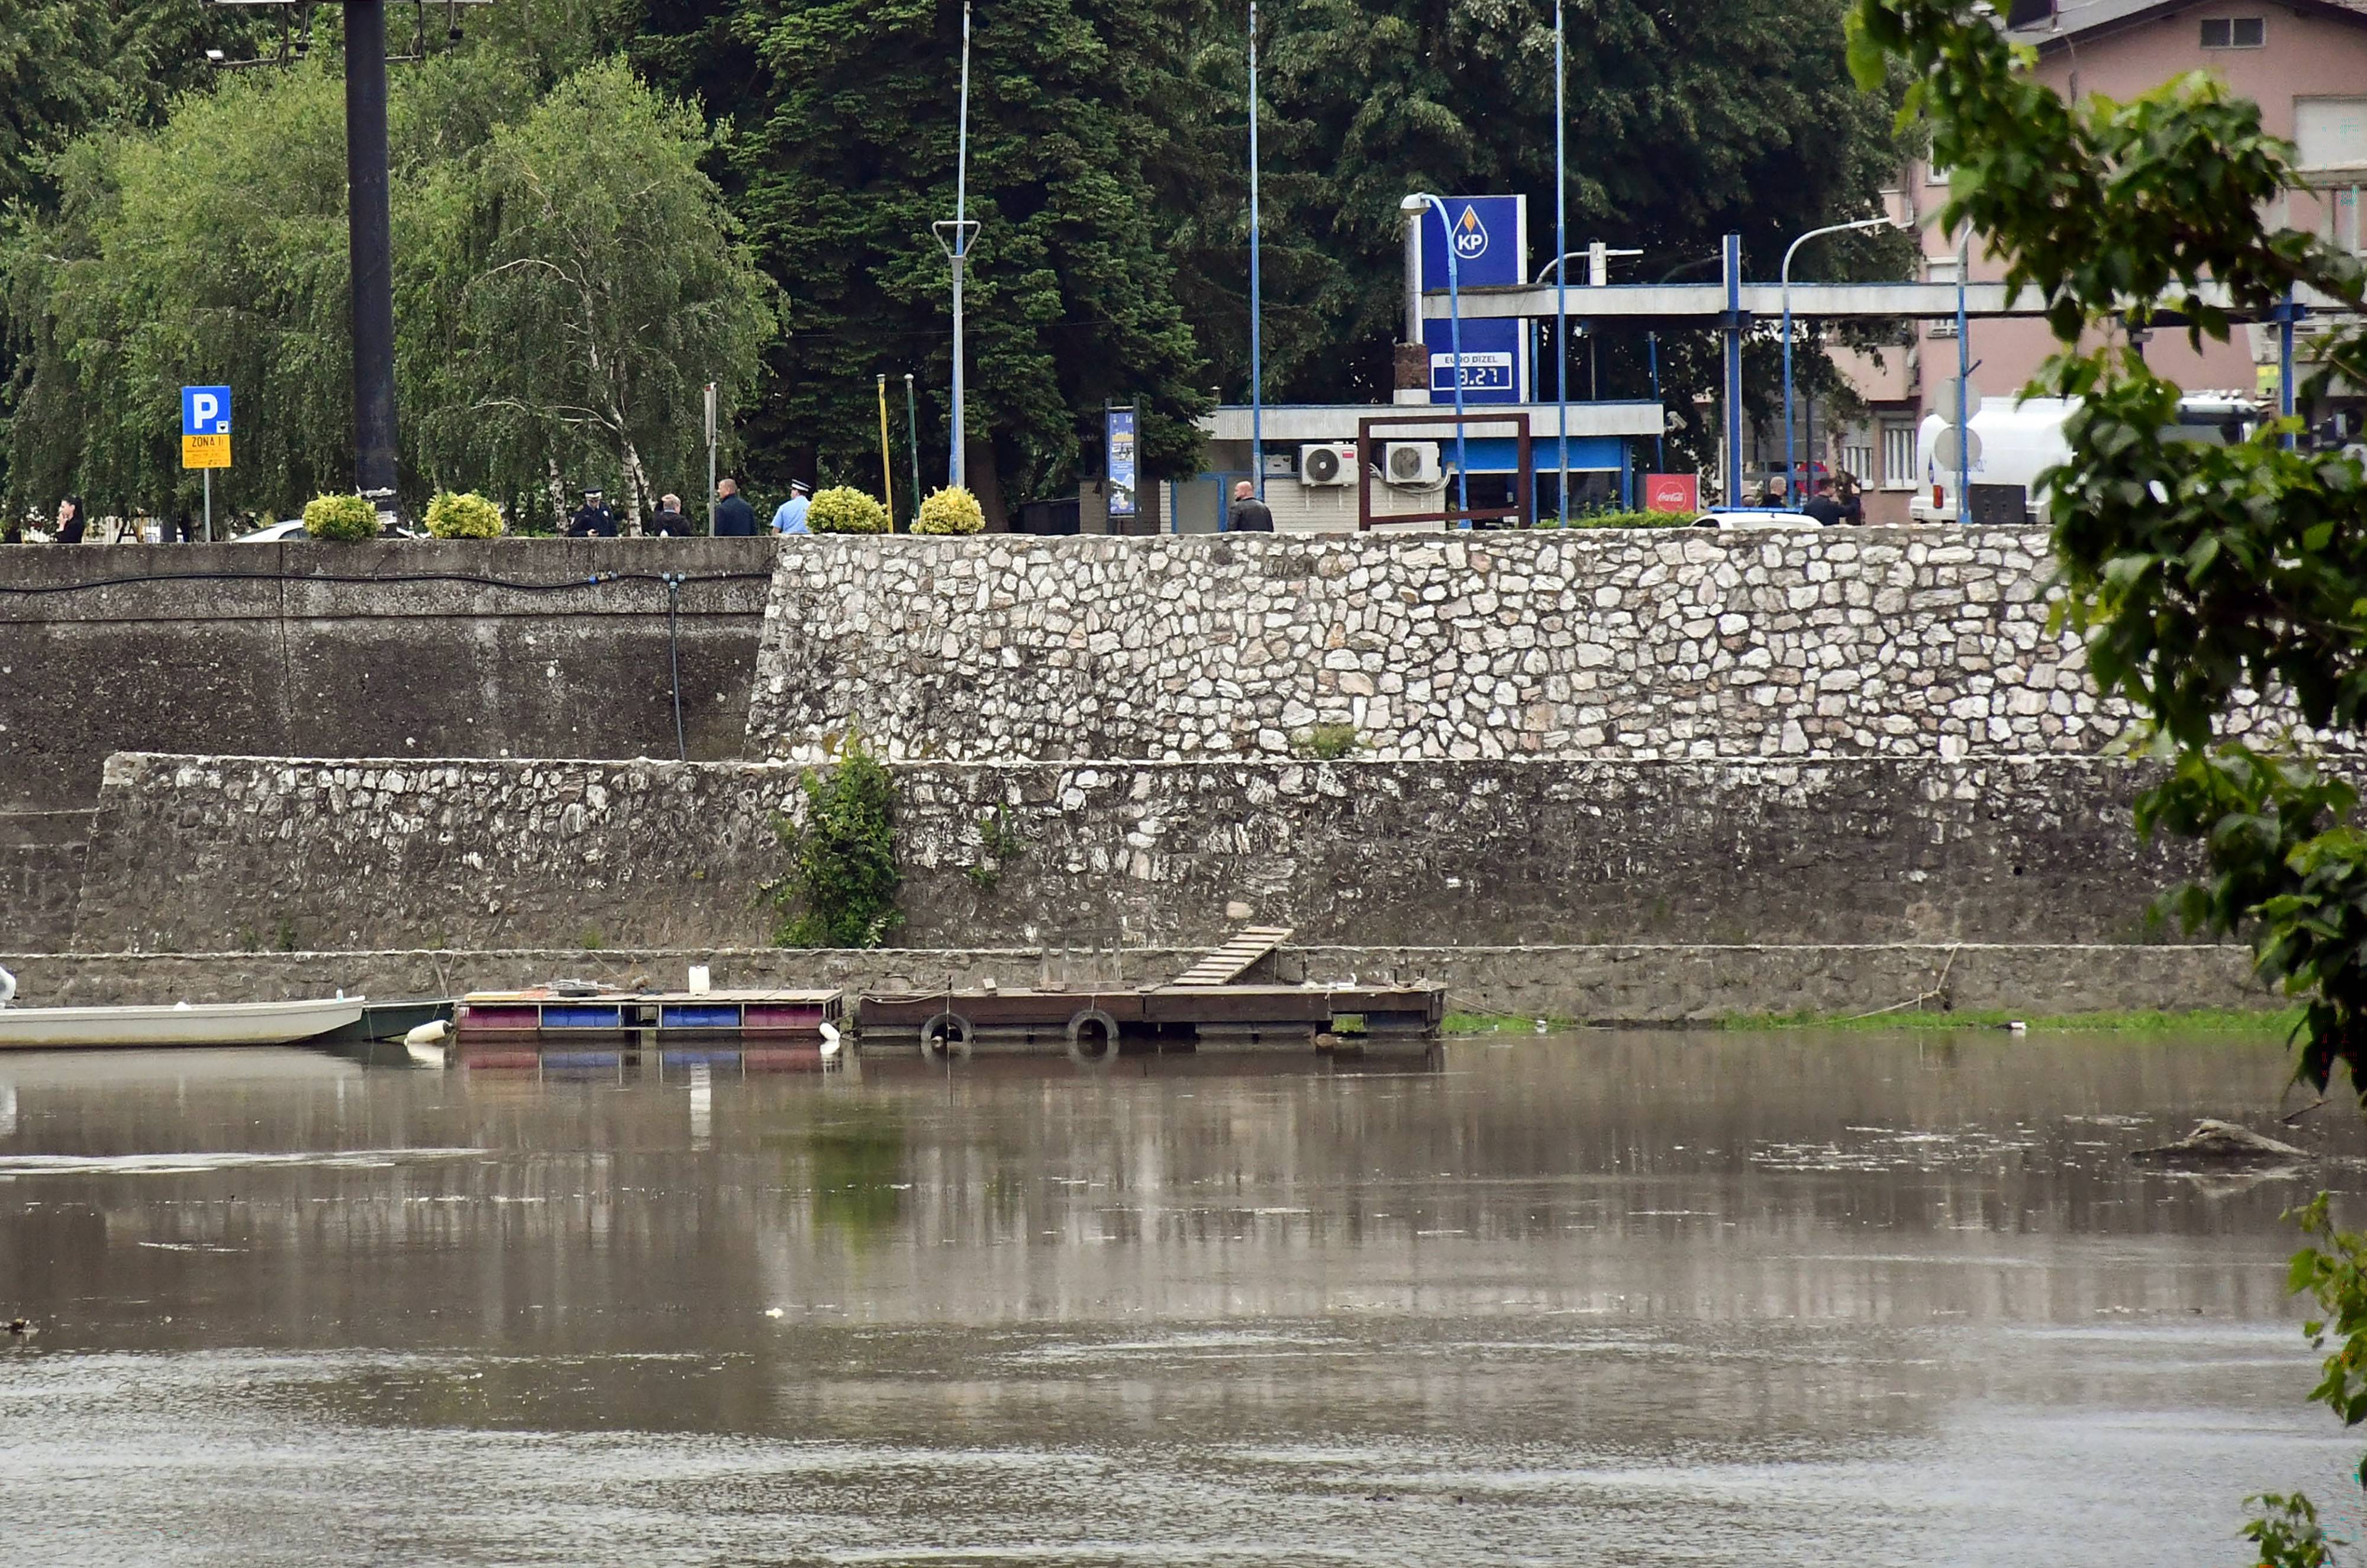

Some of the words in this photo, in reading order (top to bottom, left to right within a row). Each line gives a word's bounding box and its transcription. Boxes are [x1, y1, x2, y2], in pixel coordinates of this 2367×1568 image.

[1458, 234, 1482, 250] KP
[193, 394, 218, 429] P
[192, 437, 215, 447] ZONA
